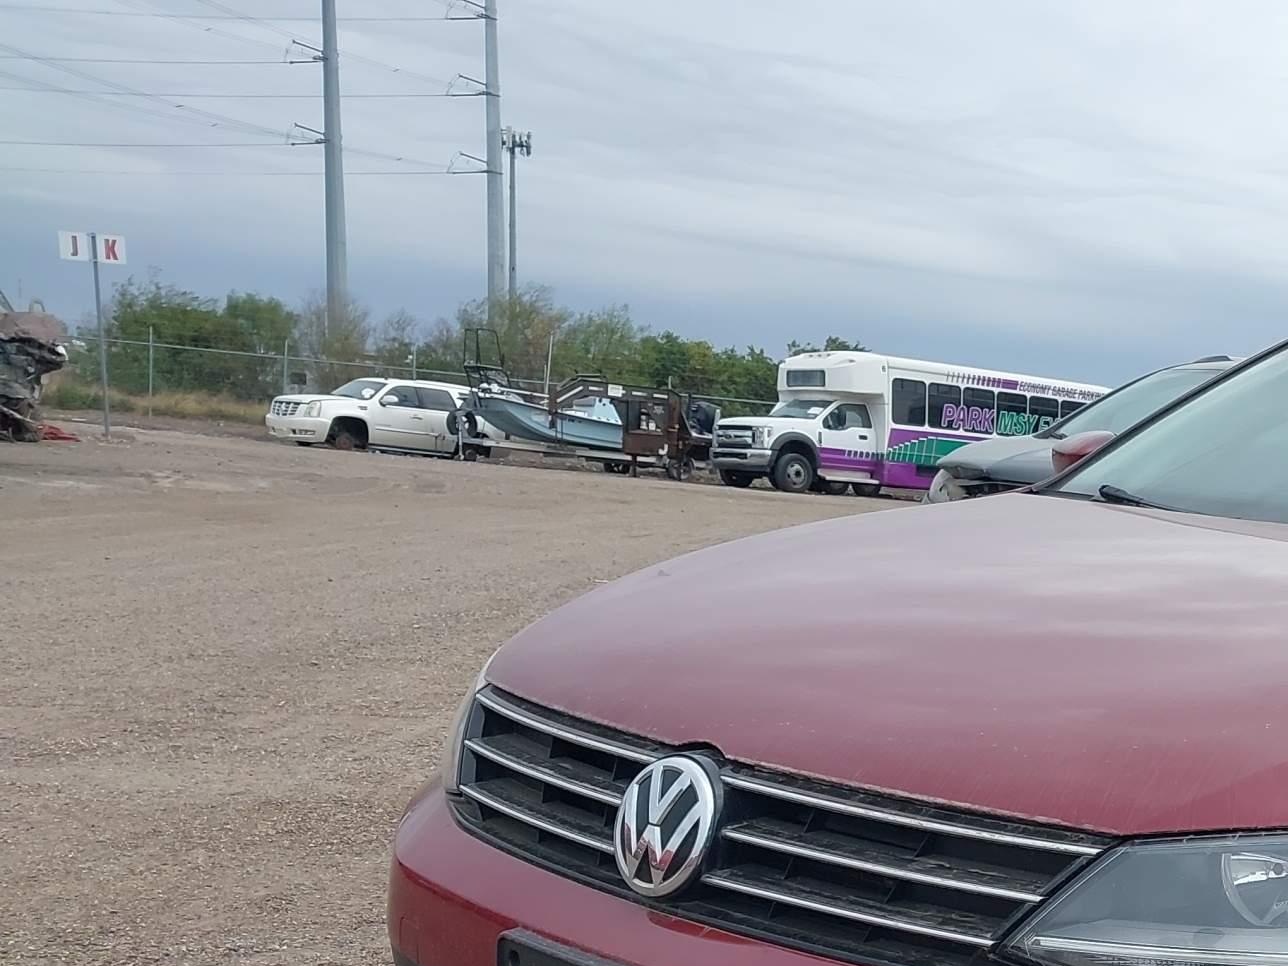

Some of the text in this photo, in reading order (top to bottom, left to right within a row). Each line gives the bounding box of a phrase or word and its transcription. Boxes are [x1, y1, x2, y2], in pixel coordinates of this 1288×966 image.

[71, 235, 79, 256] J
[104, 238, 119, 260] K
[941, 403, 995, 432] PARK
[997, 411, 1039, 436] MSY
